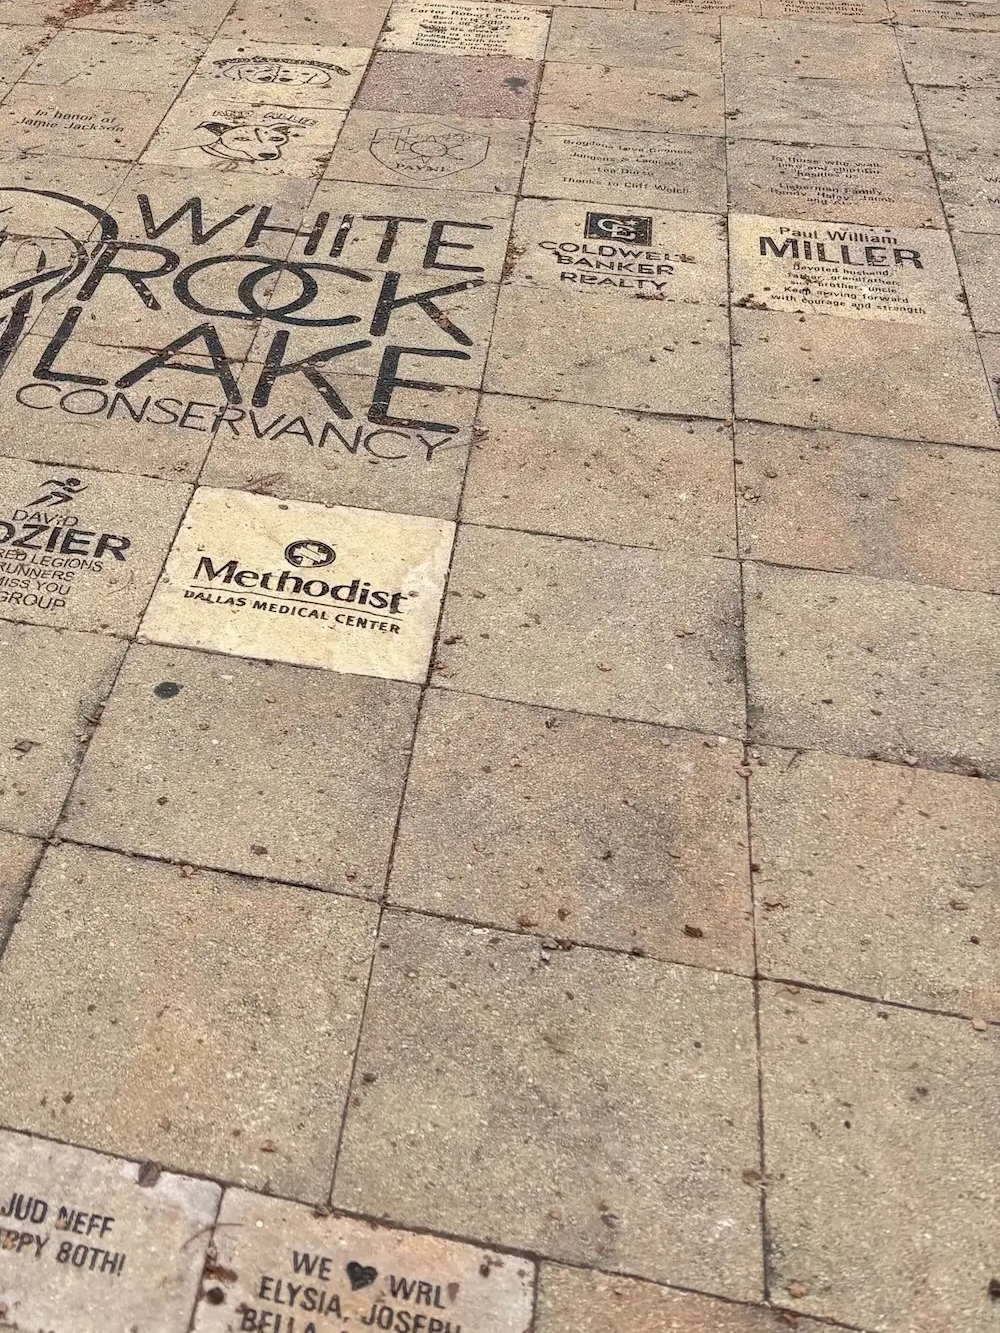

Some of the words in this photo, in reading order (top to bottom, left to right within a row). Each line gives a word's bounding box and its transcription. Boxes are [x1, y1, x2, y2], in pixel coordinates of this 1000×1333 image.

[409, 7, 447, 16] Carter
[450, 10, 491, 19] Robert
[16, 116, 59, 128] Jamie
[63, 122, 125, 133] Jackson
[35, 109, 48, 117] In
[53, 110, 97, 121] honor
[100, 116, 118, 124] of
[562, 176, 603, 186] Thanks
[654, 184, 690, 194] Welch
[134, 193, 495, 275] WHITE
[778, 225, 820, 240] Paul
[825, 230, 899, 246] William
[555, 251, 675, 276] BANKER
[758, 234, 925, 270] MILLER
[558, 270, 669, 292] REALTY
[74, 240, 488, 348] ROCK
[770, 292, 800, 304] with
[800, 297, 849, 309] courage
[850, 300, 875, 311] and
[876, 304, 928, 316] strength
[861, 294, 910, 304] forward
[31, 306, 474, 436] LAKE
[15, 384, 458, 463] CONSERVANCY
[10, 508, 81, 528] DAVID
[28, 552, 106, 574] LEGIONS
[34, 578, 74, 596] YOU
[192, 555, 410, 616] Methodist
[182, 589, 249, 609] DALLAS
[251, 599, 331, 622] MEDICAL
[333, 611, 403, 635] CENTER
[53, 1205, 116, 1241] NEFF
[54, 1238, 129, 1279] 80TH!
[290, 1250, 334, 1283] WE
[387, 1274, 447, 1310] WRL
[258, 1275, 350, 1322] ELYSIA,
